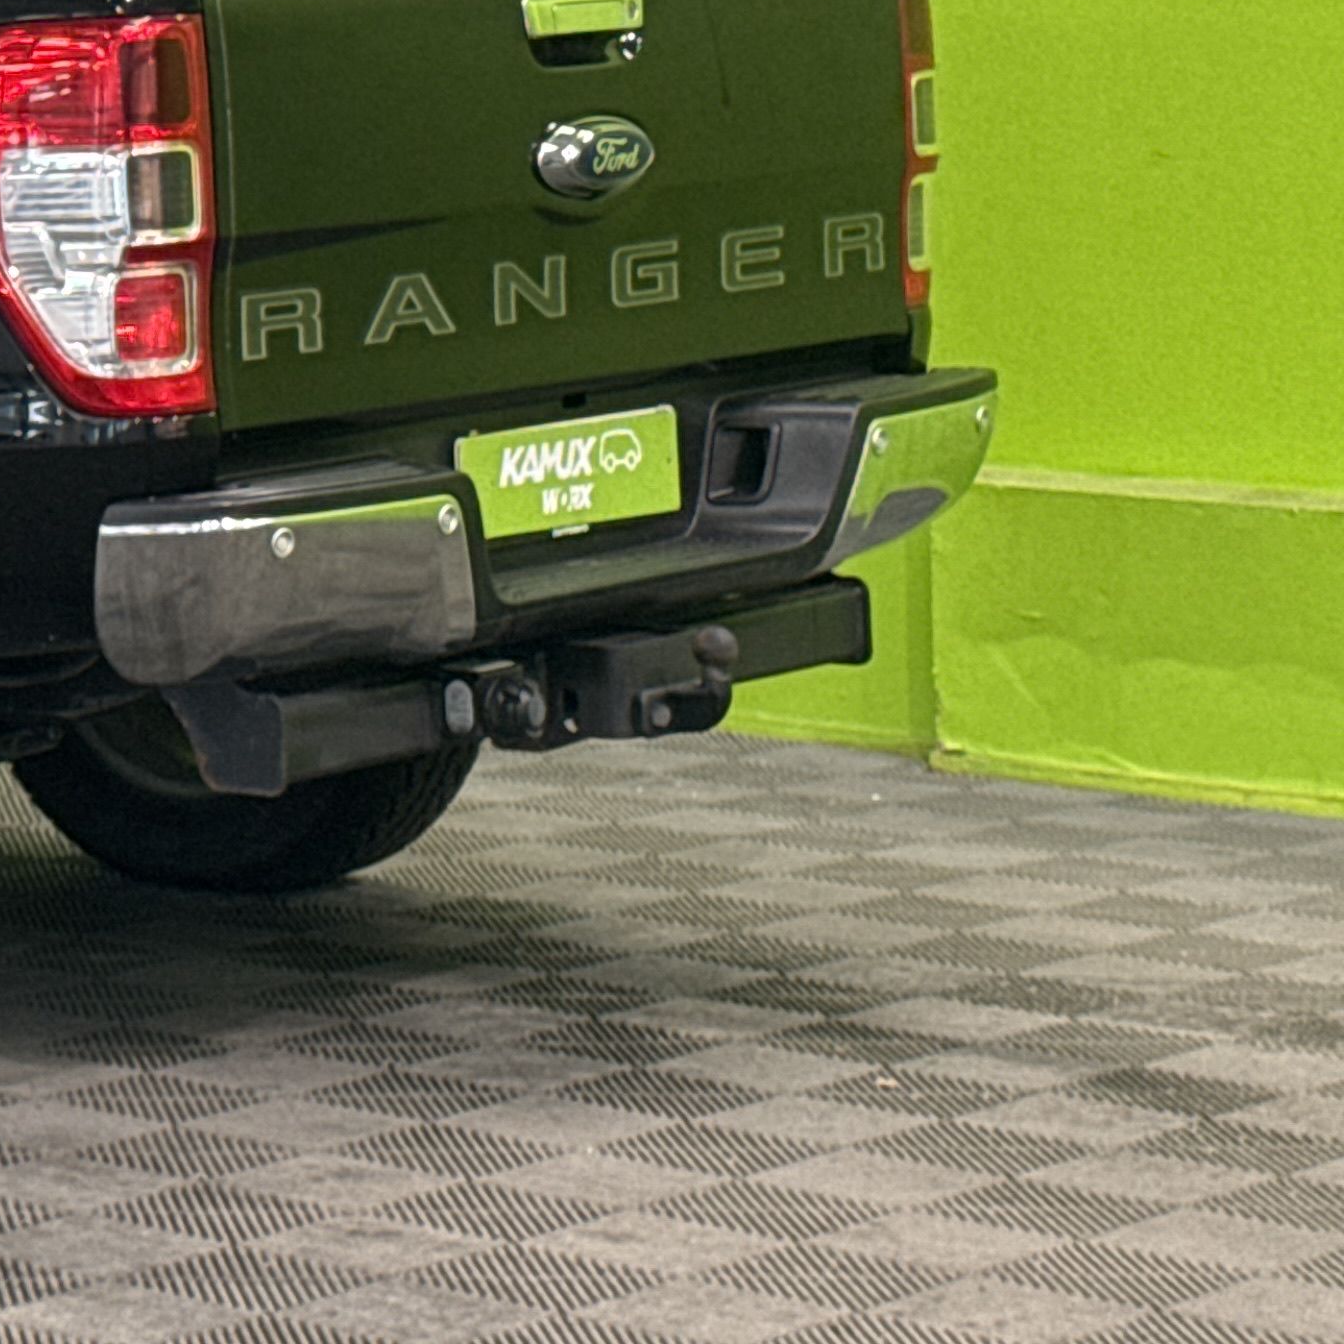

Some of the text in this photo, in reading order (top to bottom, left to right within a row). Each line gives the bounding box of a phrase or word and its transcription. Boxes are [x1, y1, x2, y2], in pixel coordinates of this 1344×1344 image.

[592, 137, 638, 176] Ford
[240, 212, 885, 362] RANGER
[499, 435, 597, 489] KAMUX
[542, 482, 595, 516] WORX
